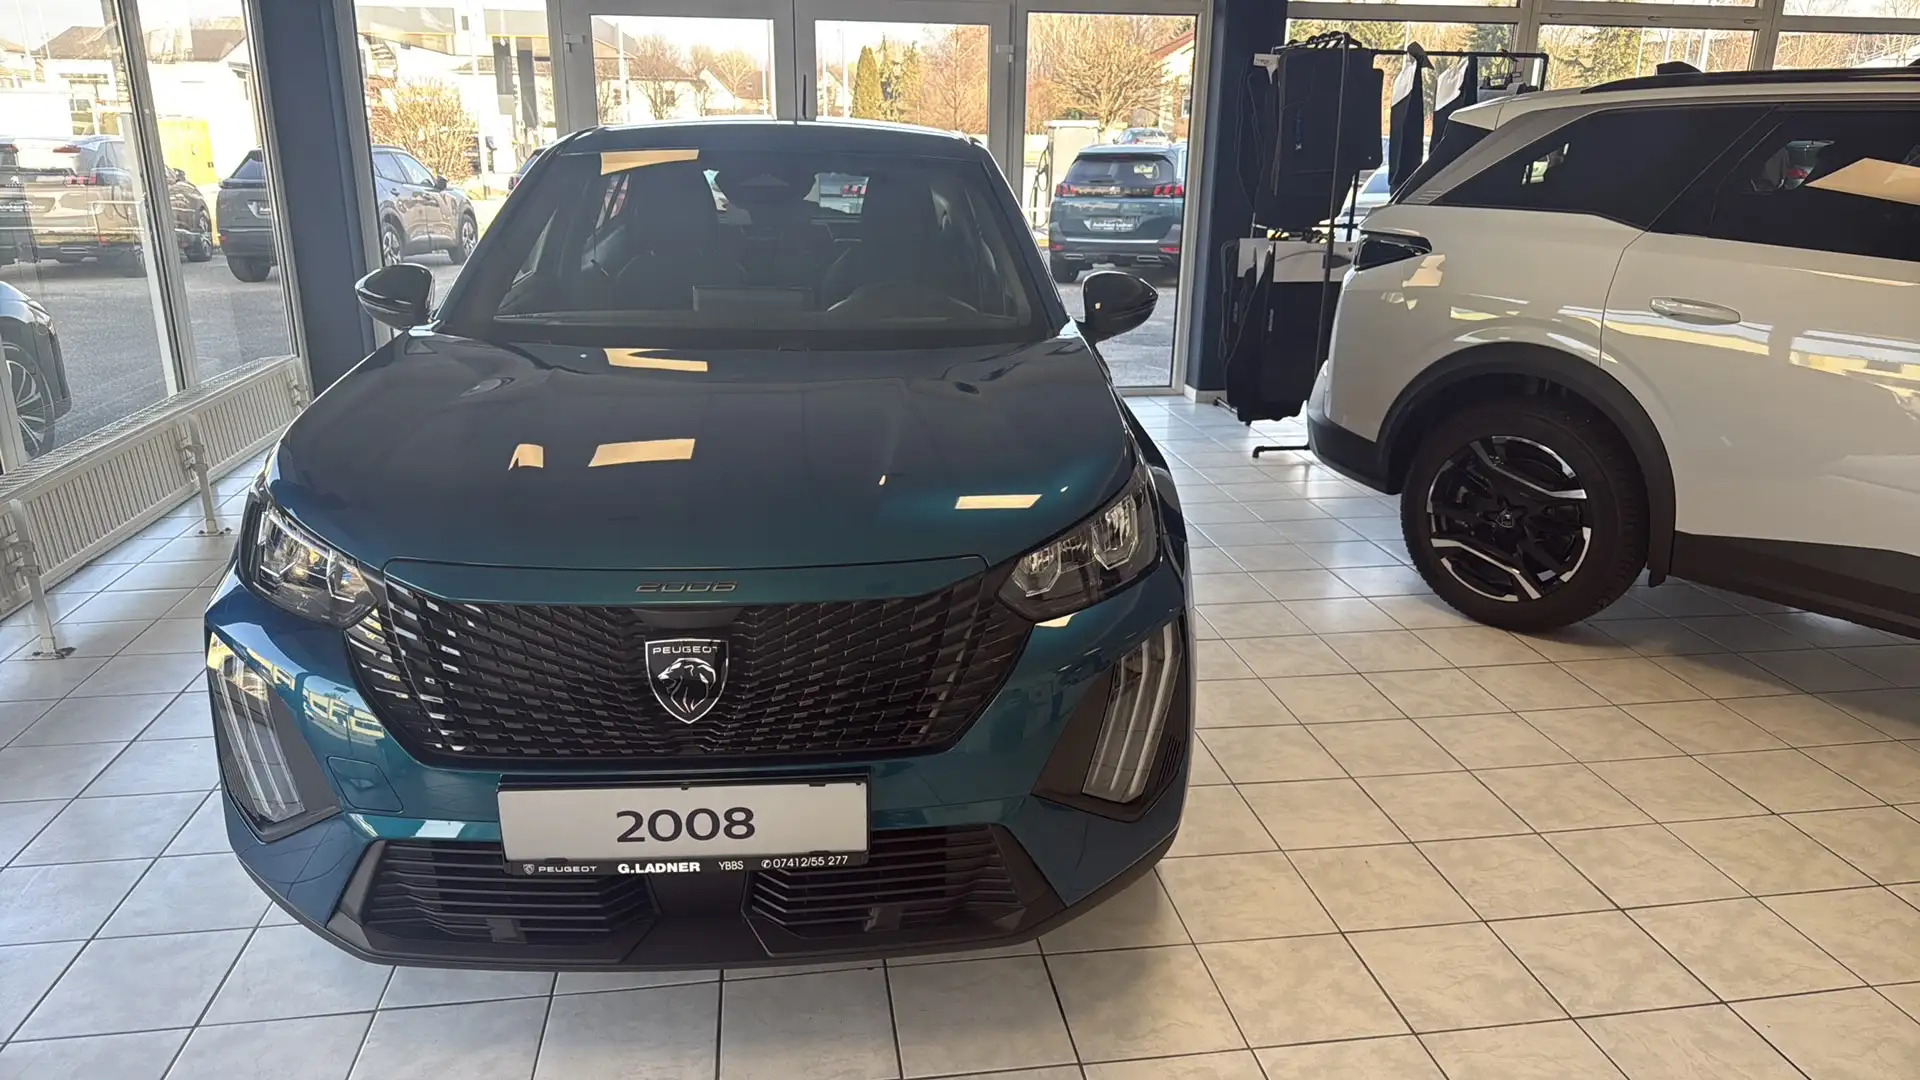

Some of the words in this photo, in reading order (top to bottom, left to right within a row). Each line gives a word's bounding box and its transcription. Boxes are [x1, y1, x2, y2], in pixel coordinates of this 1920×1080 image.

[635, 581, 737, 593] 2008
[652, 646, 718, 655] PEUGEOT
[616, 807, 756, 843] 2008
[538, 864, 597, 873] PEUGEOT
[617, 861, 701, 875] G.LADNER
[718, 860, 744, 871] YBBS
[772, 856, 825, 869] 07412/55
[827, 855, 848, 866] 277
